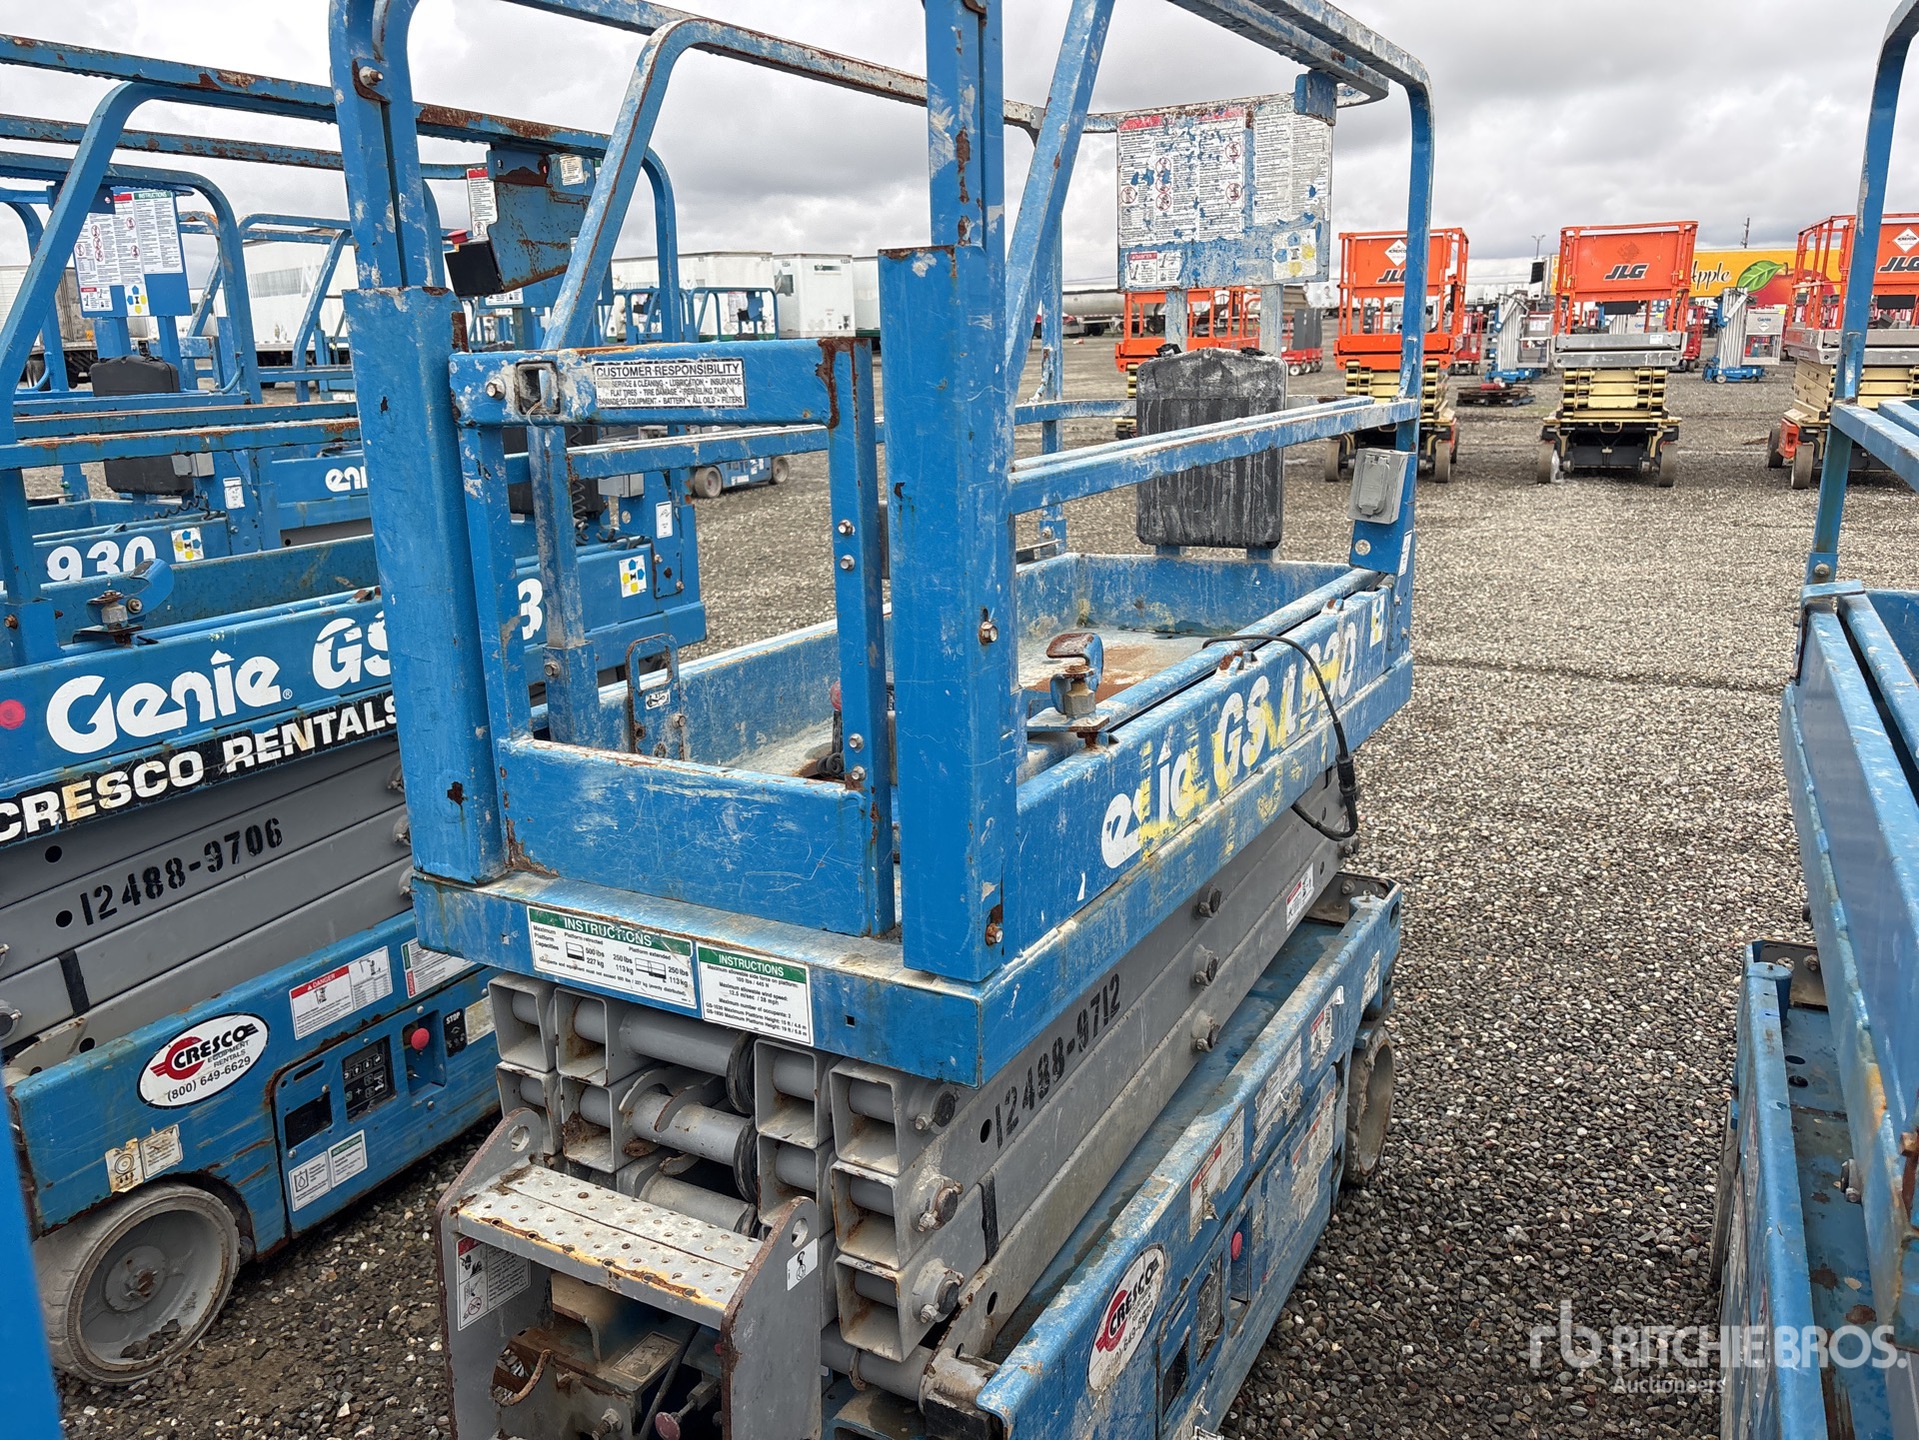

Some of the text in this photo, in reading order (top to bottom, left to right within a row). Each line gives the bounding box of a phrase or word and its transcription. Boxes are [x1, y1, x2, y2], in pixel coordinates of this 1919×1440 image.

[1605, 264, 1648, 280] JLG
[1876, 256, 1919, 272] JLG
[596, 363, 739, 377] CUSTOMER RESPONSIBILITY
[0, 750, 205, 842] CRESCO
[80, 816, 284, 926] 12488-9706
[563, 917, 653, 947] INSTRUCTIONS
[718, 954, 785, 977] INSTRUCTIONS
[313, 973, 336, 988] DANGER
[446, 1011, 461, 1025] STOP
[173, 1024, 250, 1069] CRESCO
[207, 1040, 250, 1063] EQUIPMENT
[213, 1049, 246, 1068] RENTALS
[995, 973, 1121, 1150] 12488-9712
[167, 1055, 251, 1102] (800) 649-6629
[1110, 1259, 1158, 1337] CRESCO
